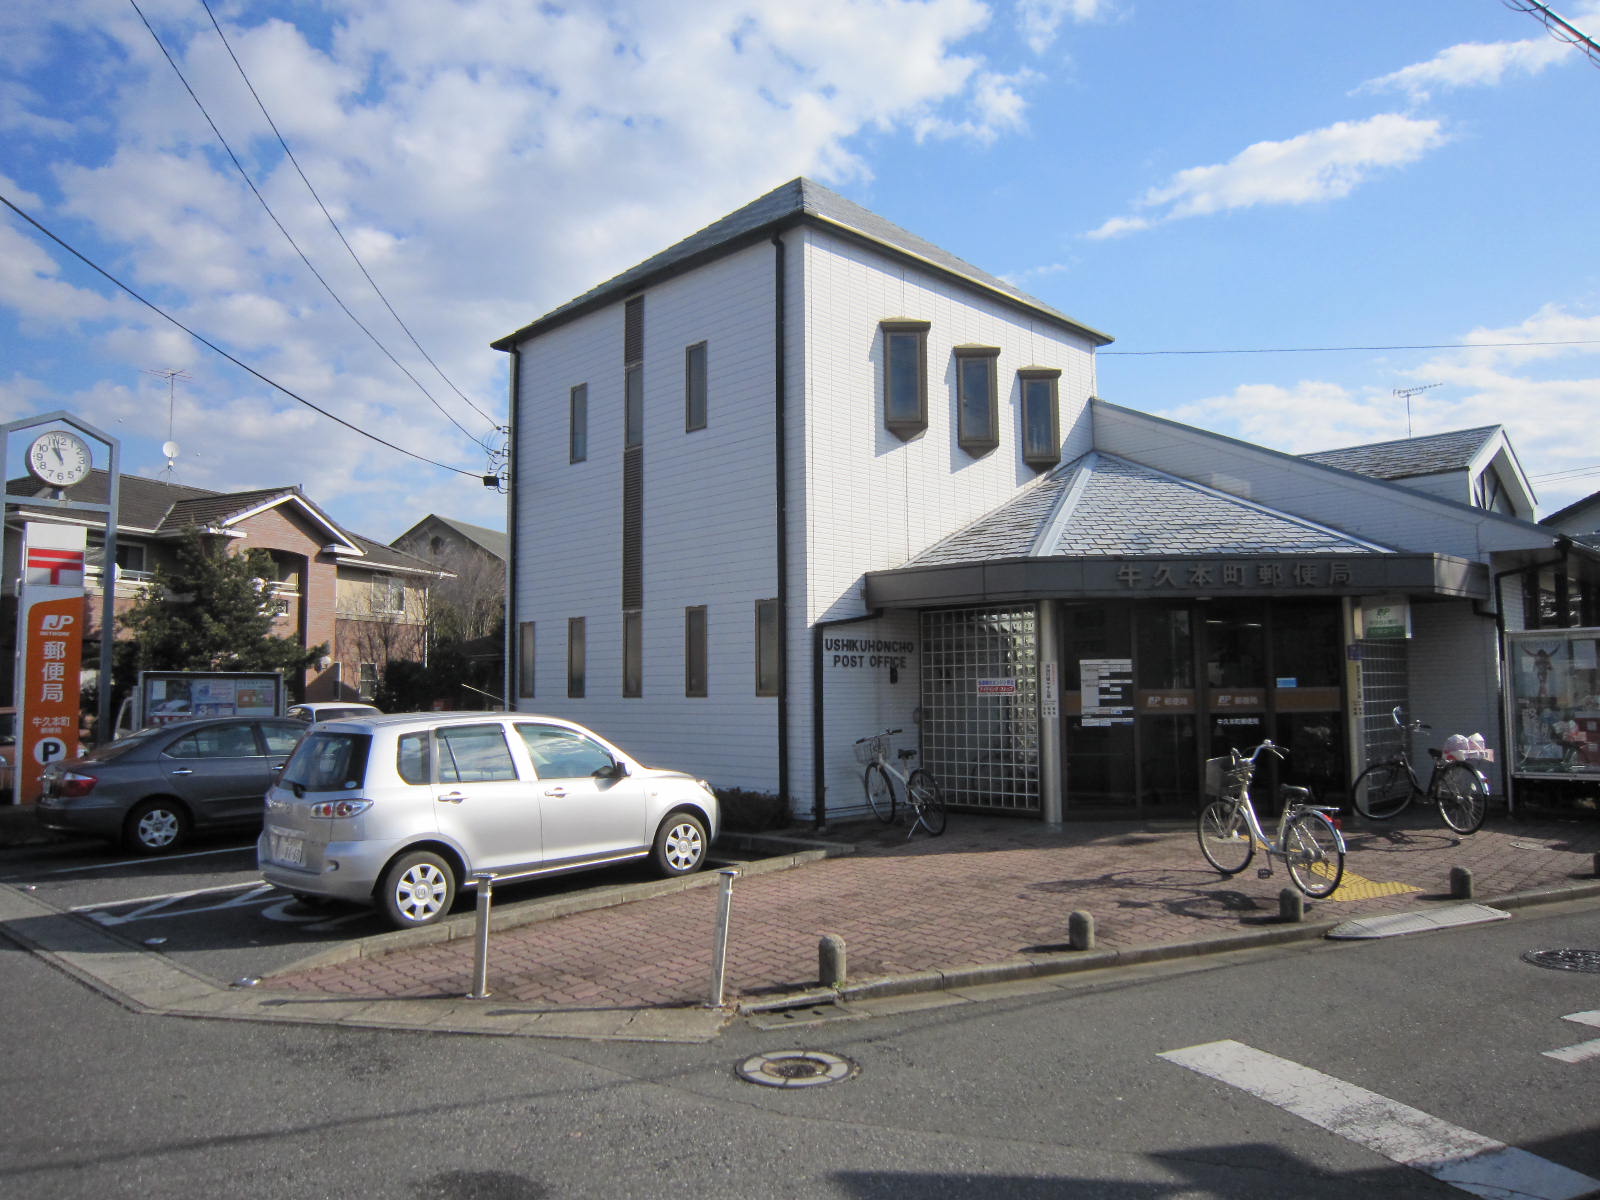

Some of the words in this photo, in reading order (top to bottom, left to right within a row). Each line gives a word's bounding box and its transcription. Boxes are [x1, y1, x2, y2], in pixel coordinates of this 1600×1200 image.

[38, 444, 49, 452] 10
[76, 447, 83, 455] 2
[36, 453, 44, 461] 9
[79, 456, 85, 464] 3
[40, 462, 47, 470] 8
[68, 471, 74, 479] 5
[1118, 562, 1351, 587] 牛久本町郵便局
[825, 638, 914, 653] USHIKUHONCHO
[833, 655, 864, 668] POST
[869, 655, 907, 669] OFFICE
[41, 641, 66, 703] 郵便局
[42, 742, 60, 762] P
